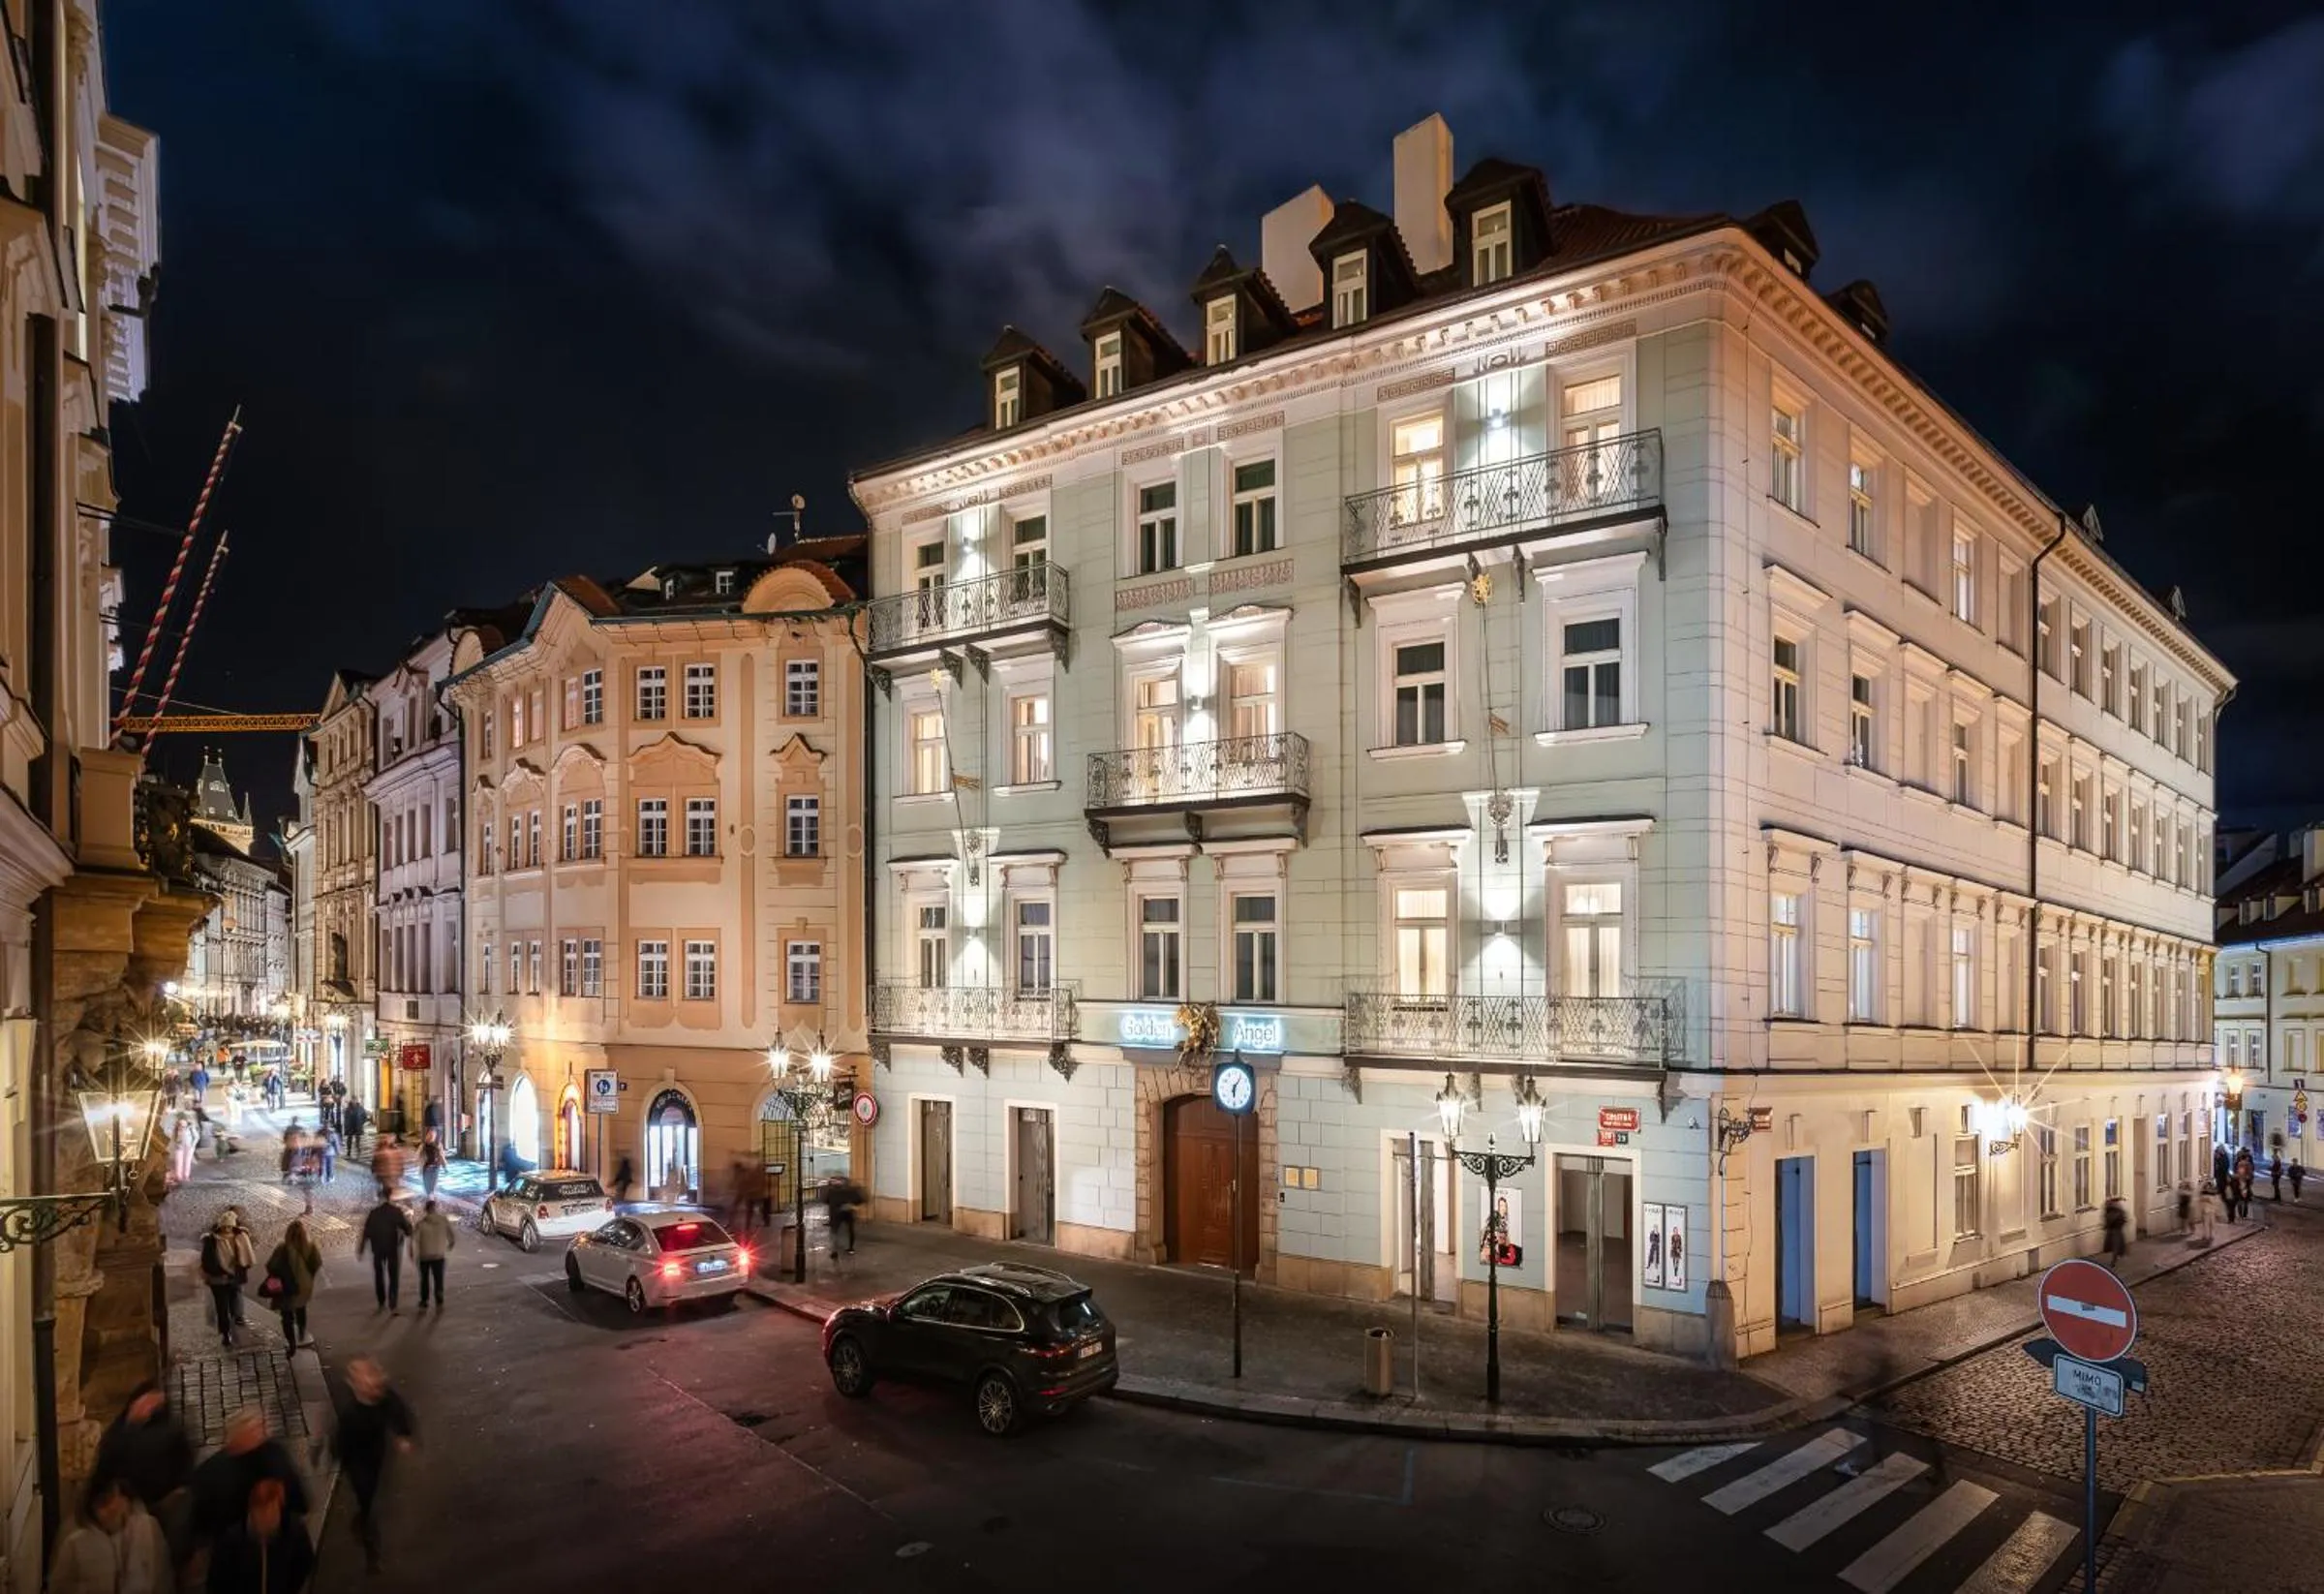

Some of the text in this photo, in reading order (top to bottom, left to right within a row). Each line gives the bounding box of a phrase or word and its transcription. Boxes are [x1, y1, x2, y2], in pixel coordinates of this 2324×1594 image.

[1123, 1017, 1276, 1046] Golden Angel
[2073, 1368, 2101, 1386] MIMO
